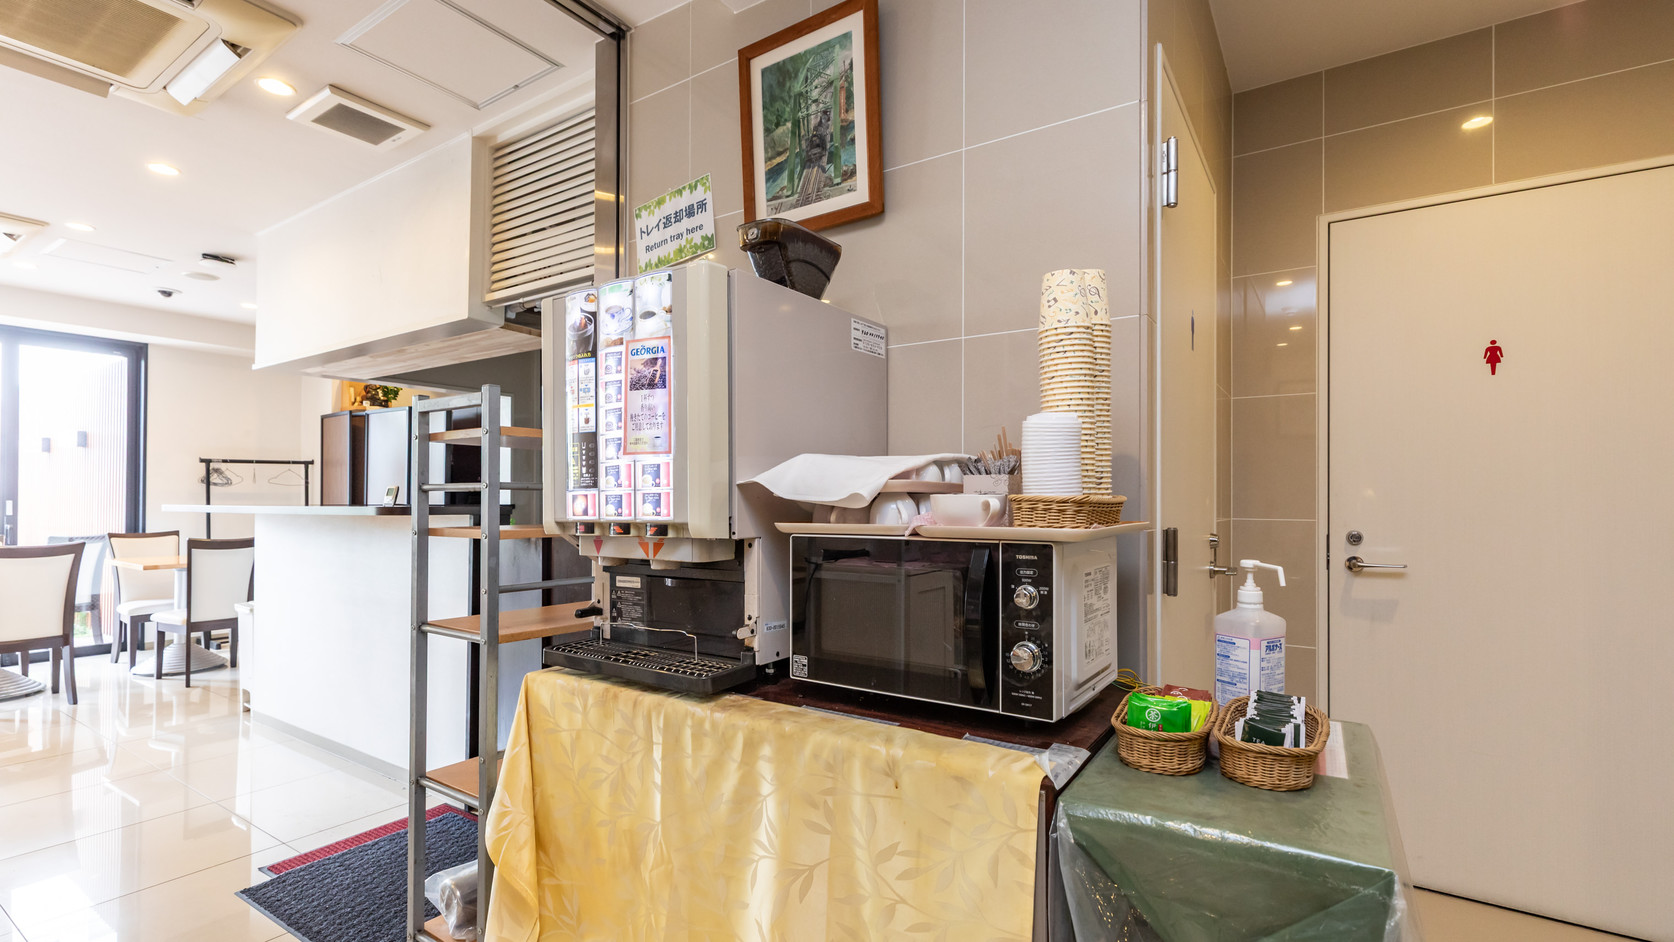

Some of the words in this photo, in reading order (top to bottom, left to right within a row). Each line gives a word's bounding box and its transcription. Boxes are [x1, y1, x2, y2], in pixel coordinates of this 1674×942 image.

[640, 198, 708, 240] トレイ返却場所
[645, 239, 668, 253] Return
[669, 231, 685, 242] tray
[685, 223, 704, 236] here
[630, 345, 665, 356] GEORGIA
